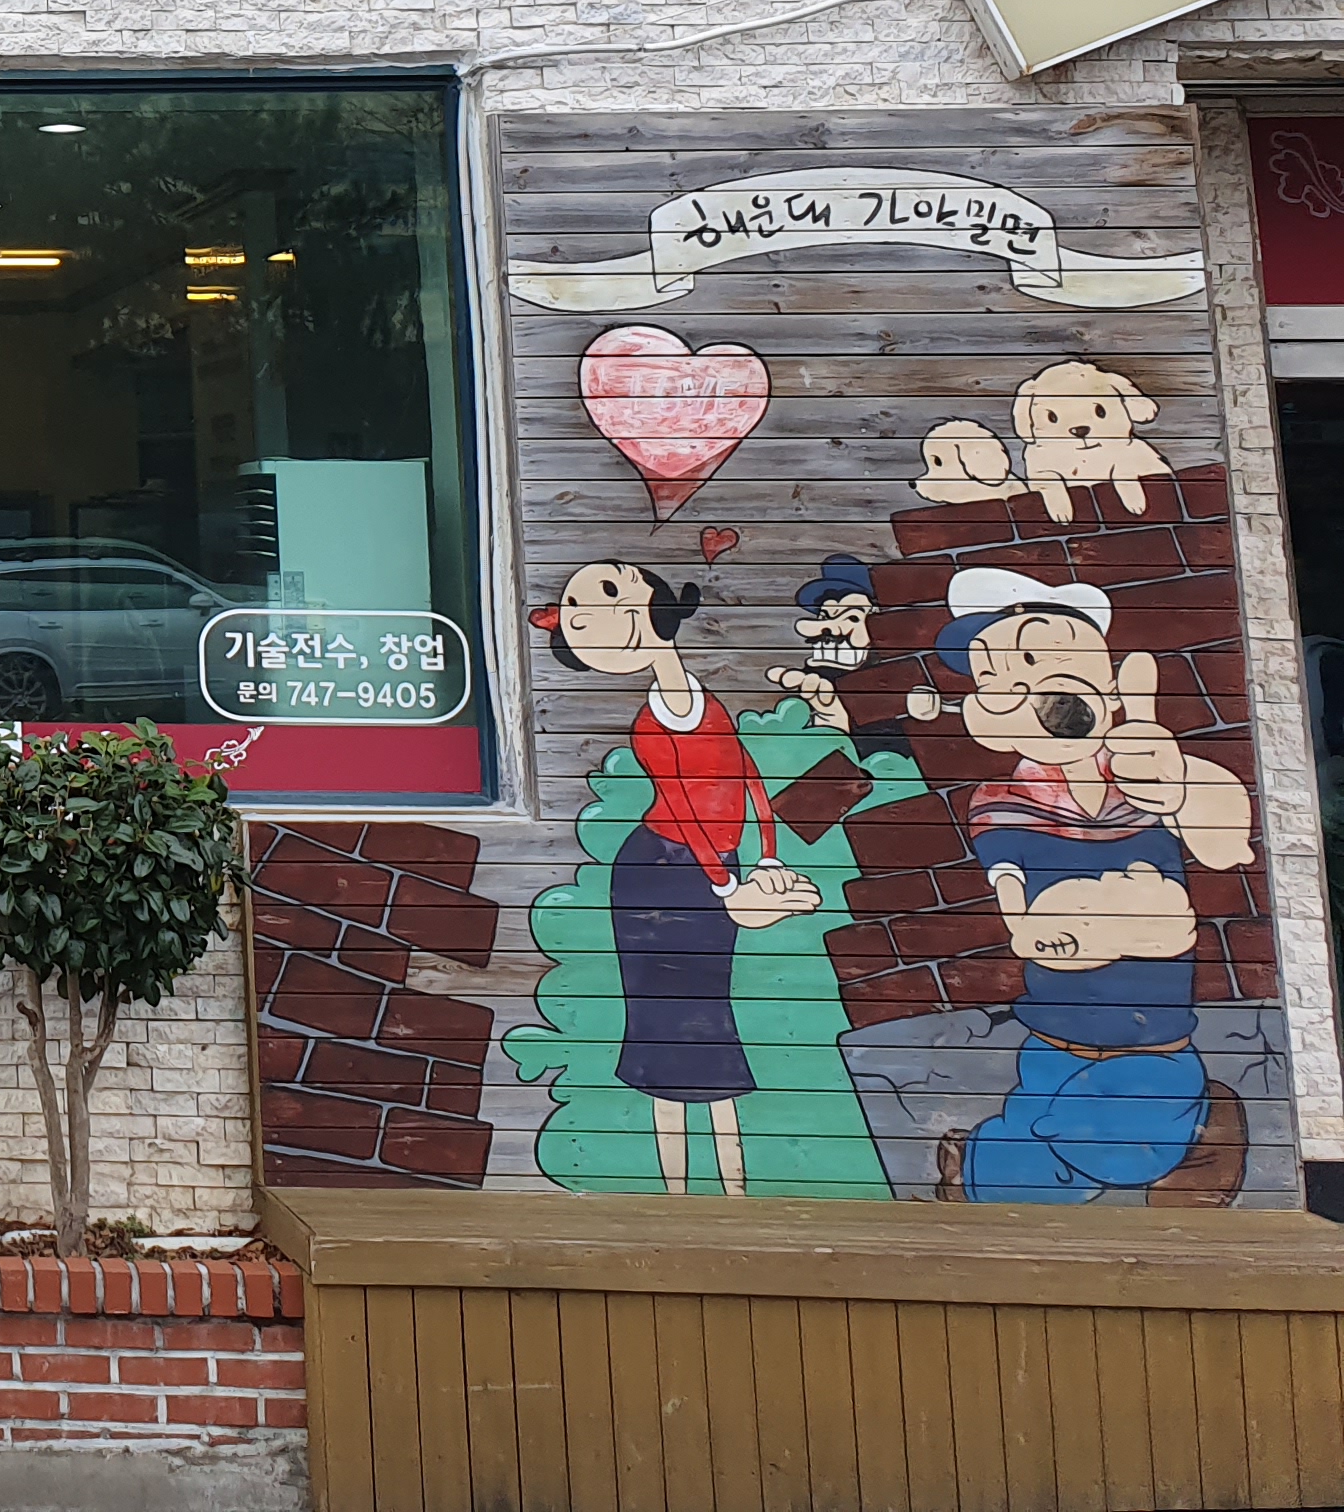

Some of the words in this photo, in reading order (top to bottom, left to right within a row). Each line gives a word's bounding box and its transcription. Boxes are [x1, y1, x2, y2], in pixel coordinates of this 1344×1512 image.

[684, 191, 831, 248] 해운대
[859, 190, 1040, 255] 가야밀면
[224, 631, 369, 669] 기술전수,
[379, 633, 446, 671] 창업
[237, 681, 277, 703] 문의
[286, 681, 436, 709] 747-9405
